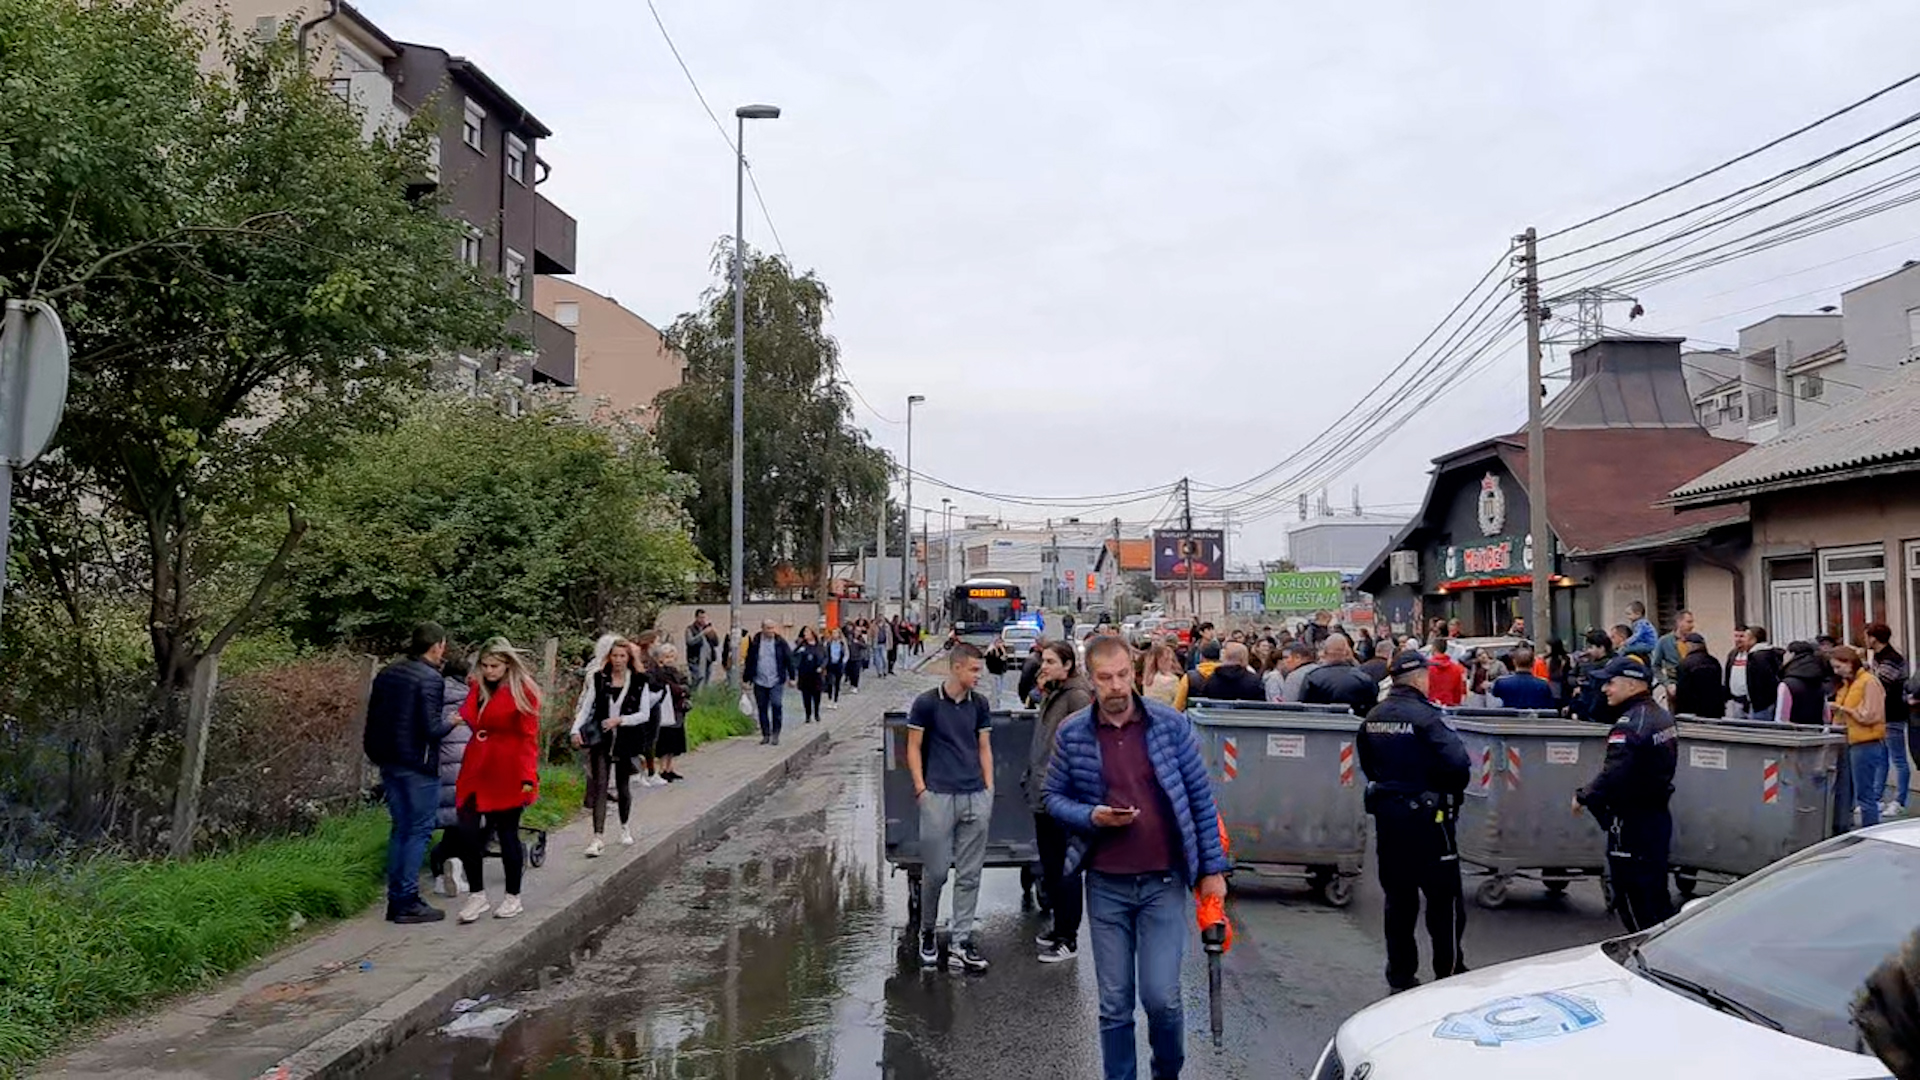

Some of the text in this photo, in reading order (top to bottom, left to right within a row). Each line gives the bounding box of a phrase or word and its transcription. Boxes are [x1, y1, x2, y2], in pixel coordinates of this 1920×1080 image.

[1282, 577, 1320, 589] SALON
[1269, 591, 1338, 604] NAMEŠTAJA
[1366, 722, 1414, 734] ПОЛИЦИЈА
